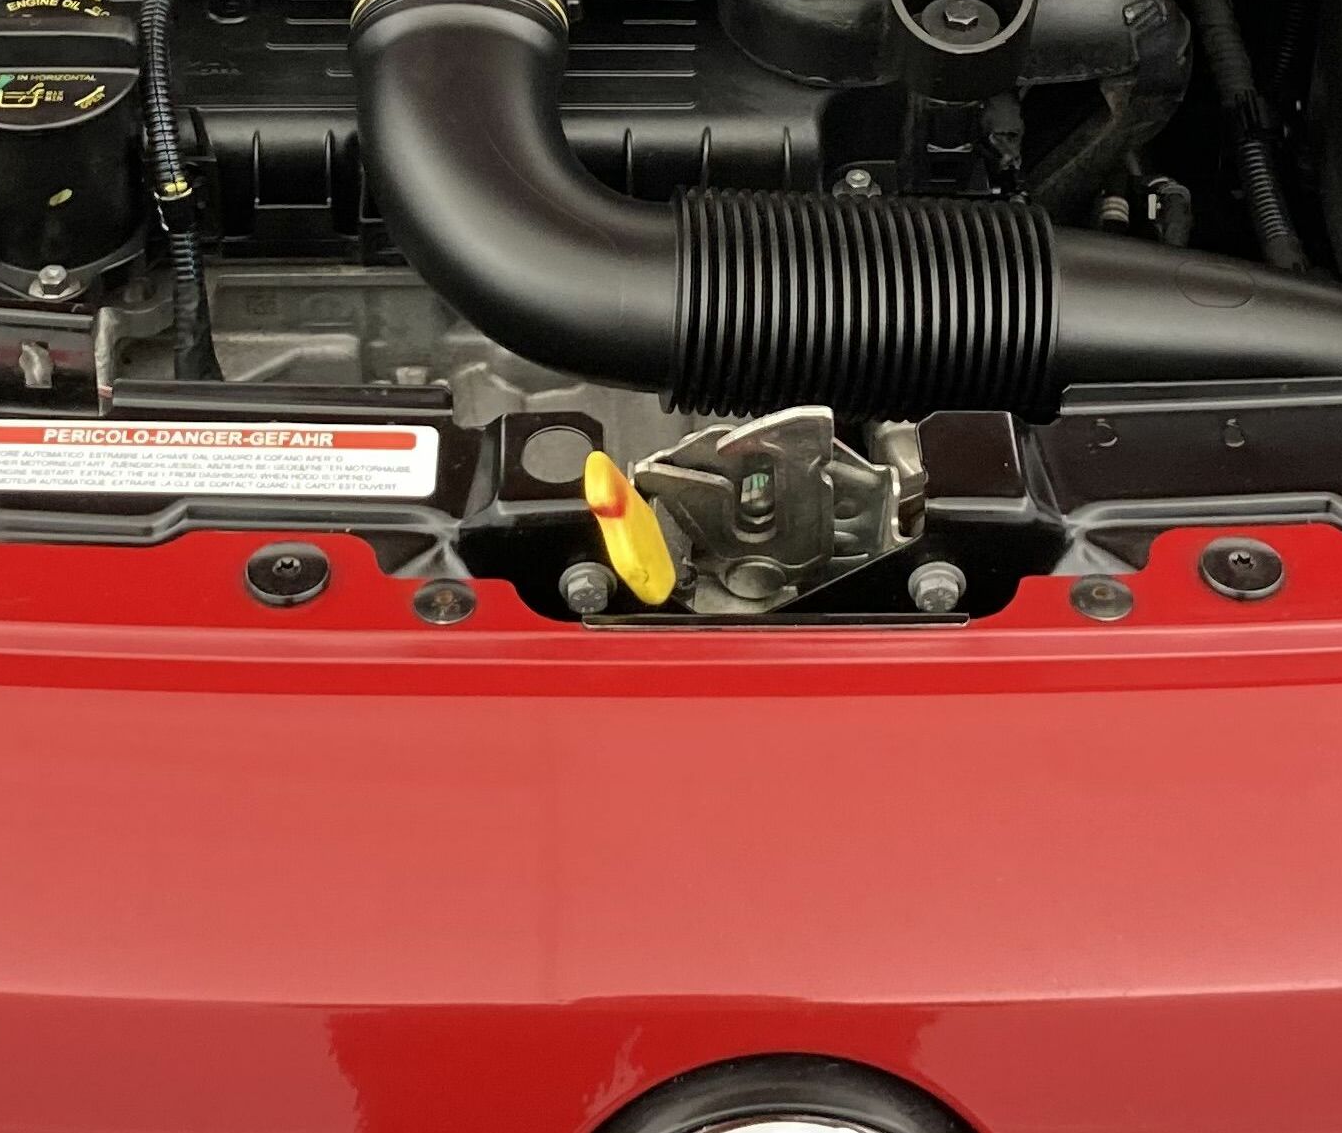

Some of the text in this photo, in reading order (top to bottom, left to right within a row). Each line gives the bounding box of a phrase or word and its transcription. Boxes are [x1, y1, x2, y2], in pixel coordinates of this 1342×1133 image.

[17, 74, 28, 82] IN
[30, 74, 97, 82] HORIZONTAL
[43, 429, 334, 446] PERICOLO-DANGER-GEFAHR
